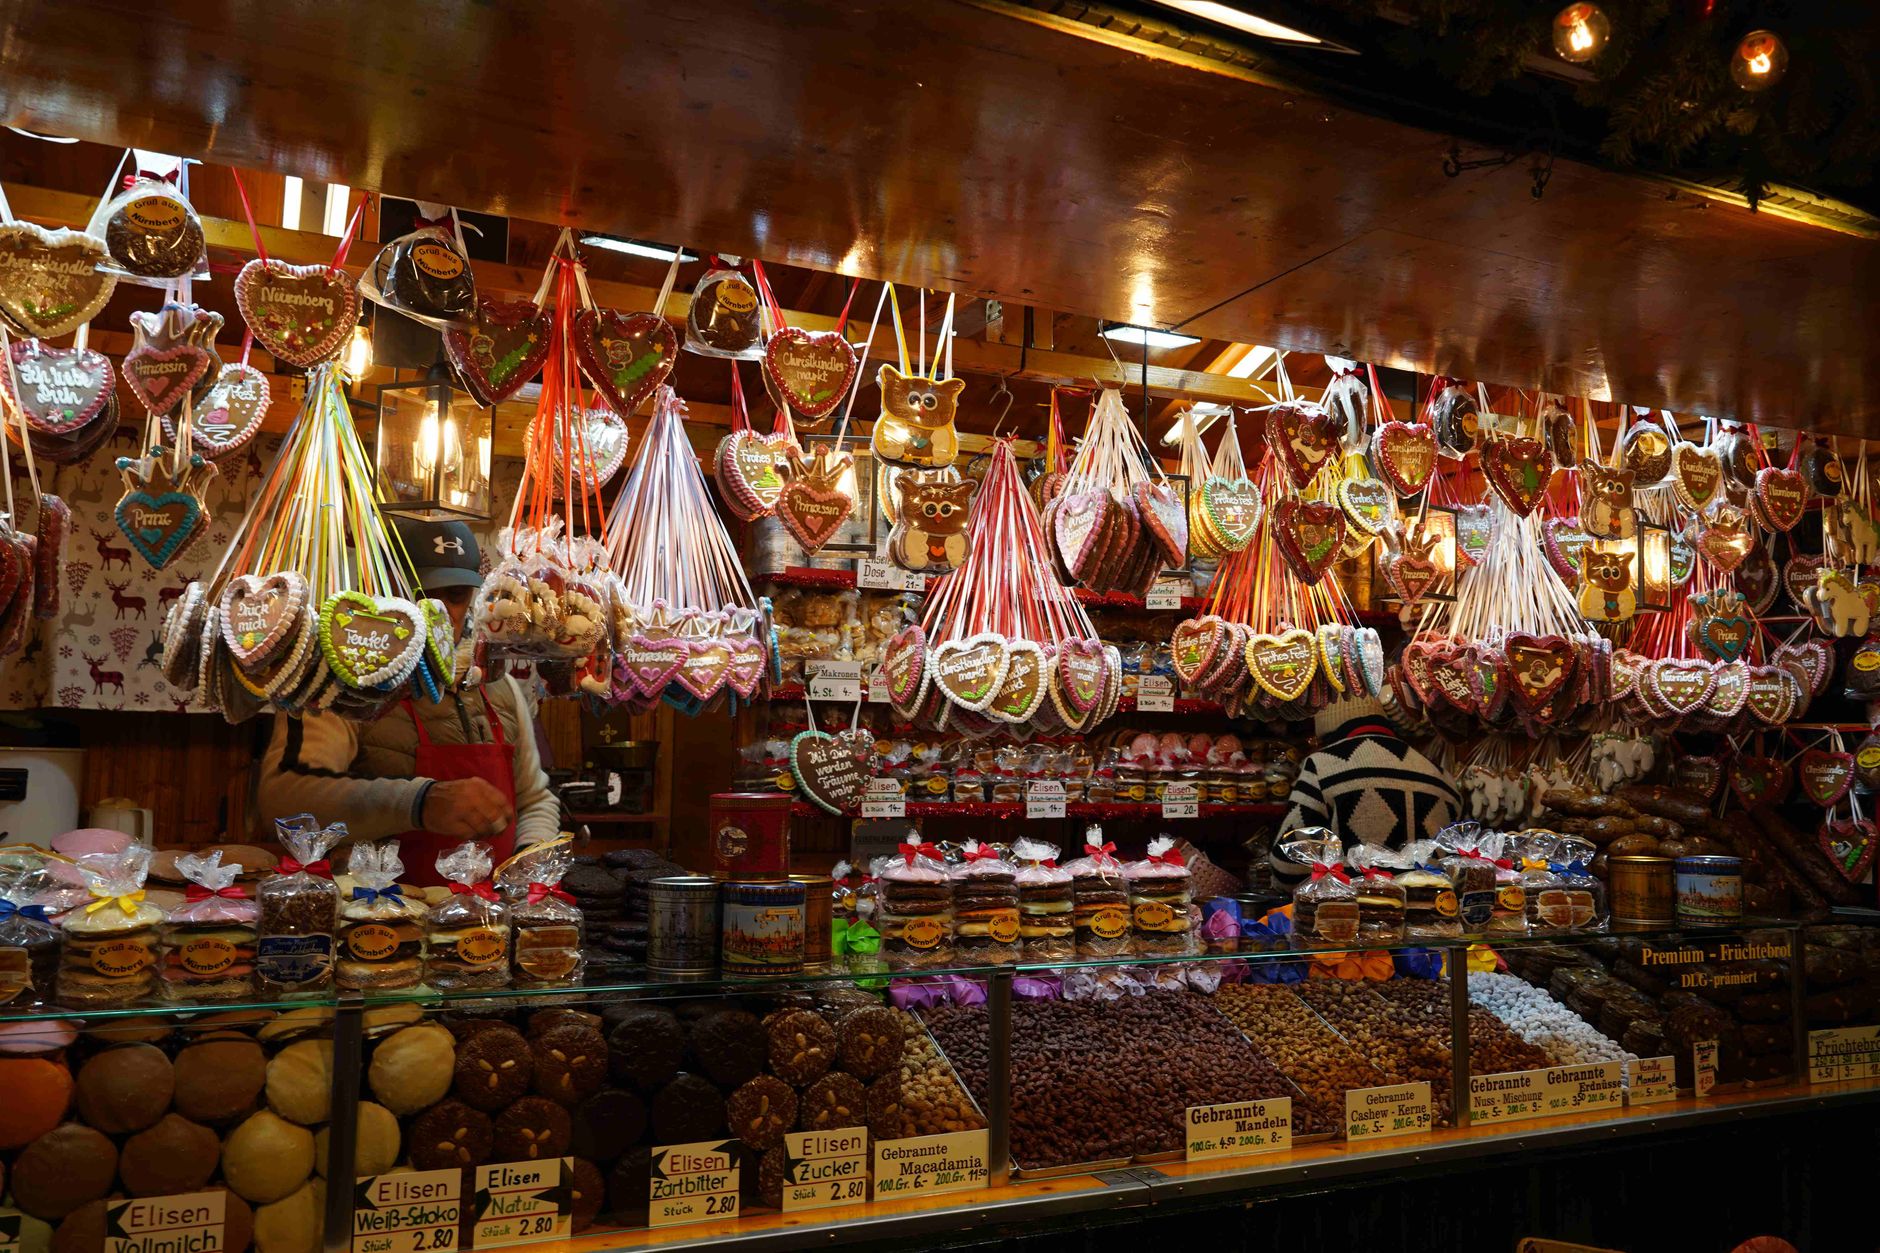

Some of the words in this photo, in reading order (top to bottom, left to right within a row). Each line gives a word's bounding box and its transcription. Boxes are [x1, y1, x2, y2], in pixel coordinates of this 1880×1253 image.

[134, 198, 158, 209] Gruß
[162, 199, 179, 212] aus
[131, 212, 180, 227] Nürnberg
[442, 252, 457, 264] aus
[416, 258, 457, 276] Nürnberg
[261, 286, 333, 315] Nürnberg
[720, 293, 754, 310] Nürnberg
[796, 369, 828, 383] markt
[740, 449, 771, 464] Frohes
[863, 565, 886, 577] Dose
[238, 618, 268, 633] mich
[344, 628, 390, 650] Teufel
[1256, 650, 1289, 667] Frohes
[1289, 647, 1311, 660] Fest
[820, 669, 859, 679] Makronen
[957, 666, 988, 682] markt
[1143, 678, 1169, 688] Elisen
[822, 687, 835, 698] St.
[815, 761, 853, 777] werden
[817, 771, 859, 789] Träume
[1033, 782, 1060, 793] Elisen
[829, 784, 856, 800] wahr
[1167, 784, 1191, 795] Elisen
[1094, 912, 1110, 923] Gruß
[1111, 911, 1124, 921] aus
[1137, 905, 1153, 917] Gruß
[1153, 906, 1169, 915] aus
[908, 921, 924, 932] Gruß
[925, 922, 939, 931] aus
[993, 915, 1009, 927] Gruß
[1137, 918, 1170, 929] Nürnberg
[354, 929, 375, 940] Gruß
[378, 929, 394, 940] aus
[1093, 925, 1125, 937] Nürnberg
[186, 941, 210, 953] Gruß
[213, 942, 231, 952] aus
[464, 934, 486, 945] Gruß
[906, 933, 941, 946] Nürnberg
[98, 943, 125, 956] Gruß
[128, 944, 144, 954] aus
[352, 943, 394, 957] Nürnberg
[461, 948, 501, 961] Nürnberg
[1641, 947, 1704, 966] Premium
[1720, 942, 1793, 962] Früchtebrot
[97, 959, 144, 973] Nürnberg
[184, 956, 231, 972] Nürnberg
[1681, 971, 1758, 988] DLG-prämiert
[1547, 1066, 1605, 1085] Gebrannte
[1471, 1075, 1531, 1093] Gebrannte
[1579, 1079, 1622, 1093] Erdnüsse
[1366, 1091, 1415, 1105] Gebrannte
[1474, 1095, 1495, 1107] Nuss
[1503, 1091, 1543, 1105] Mischung
[1191, 1103, 1266, 1125] Gebrannte
[1351, 1109, 1388, 1122] Cashew
[1397, 1104, 1427, 1116] Kerne
[1235, 1117, 1288, 1133] Mandeln
[802, 1133, 862, 1156] Elisen
[881, 1143, 948, 1162] Gebrannte
[670, 1153, 725, 1173] Elisen
[799, 1158, 860, 1182] Zucker
[899, 1155, 983, 1178] Macadamia
[488, 1168, 541, 1189] Elisen
[378, 1182, 448, 1202] Elisen
[652, 1173, 728, 1201] Zartbitter
[792, 1186, 816, 1201] Stück
[830, 1180, 863, 1201] 2.80
[491, 1195, 540, 1216] Natur
[663, 1201, 693, 1218] Stück
[705, 1195, 736, 1216] 2.80
[130, 1205, 210, 1228] Elisen
[357, 1206, 459, 1232] Weiß-Schoko
[481, 1224, 511, 1238] Stück
[518, 1217, 553, 1237] 2.80
[114, 1230, 217, 1253] Vollmilch
[362, 1240, 393, 1253] Stück
[413, 1228, 454, 1251] 2.80
